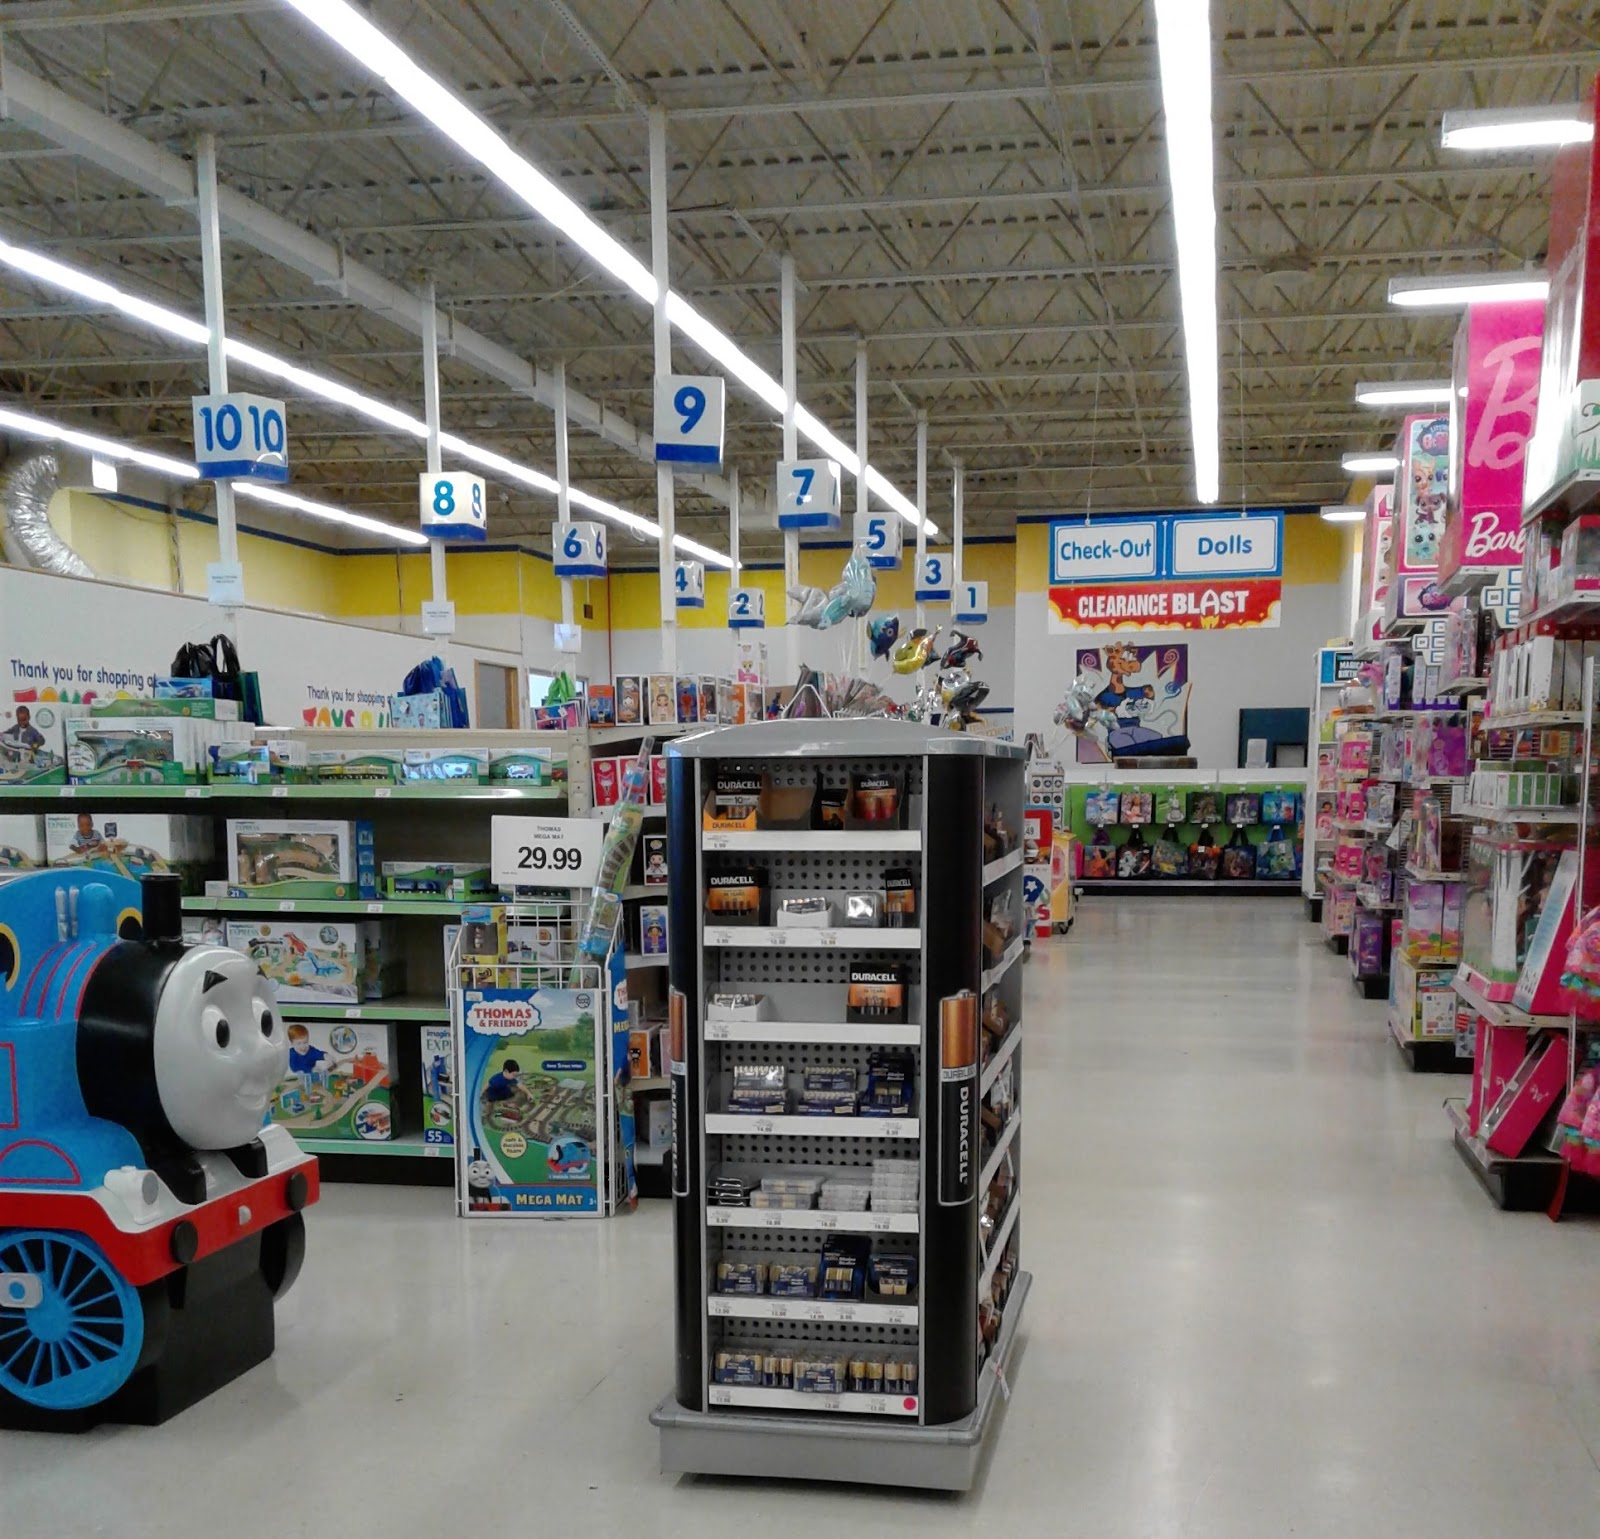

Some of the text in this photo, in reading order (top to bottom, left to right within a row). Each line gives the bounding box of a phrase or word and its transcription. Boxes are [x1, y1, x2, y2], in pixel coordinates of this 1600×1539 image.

[674, 386, 706, 434] 9
[200, 404, 242, 452] 10
[249, 406, 284, 454] 10
[433, 480, 455, 516] 8
[792, 468, 815, 506] 7
[472, 483, 482, 519] 8
[563, 528, 582, 559] 6
[595, 531, 603, 560] 6
[866, 519, 886, 550] 5
[1198, 535, 1253, 556] Dolls
[1060, 538, 1152, 561] Check-Out
[676, 567, 689, 592] 4
[925, 559, 942, 585] 3
[736, 593, 750, 615] 2
[967, 587, 976, 609] 1
[1078, 589, 1249, 618] CLEARANCE BLAST
[11, 659, 49, 679] Thank
[52, 666, 73, 685] you
[77, 664, 92, 681] for
[97, 666, 144, 691] shopping
[307, 685, 330, 700] Thank
[331, 690, 344, 704] you
[345, 688, 355, 703] for
[357, 690, 386, 708] shopping
[717, 781, 762, 790] DURACELL
[518, 846, 582, 871] 29.99
[710, 876, 755, 886] DURACELL
[851, 972, 898, 982] DURACELL
[473, 1008, 532, 1020] THOMAS
[479, 1020, 529, 1028] & FRIENDS
[427, 1131, 442, 1143] 55
[959, 1086, 970, 1184] DURACELL
[516, 1194, 584, 1206] MEGA MAT
